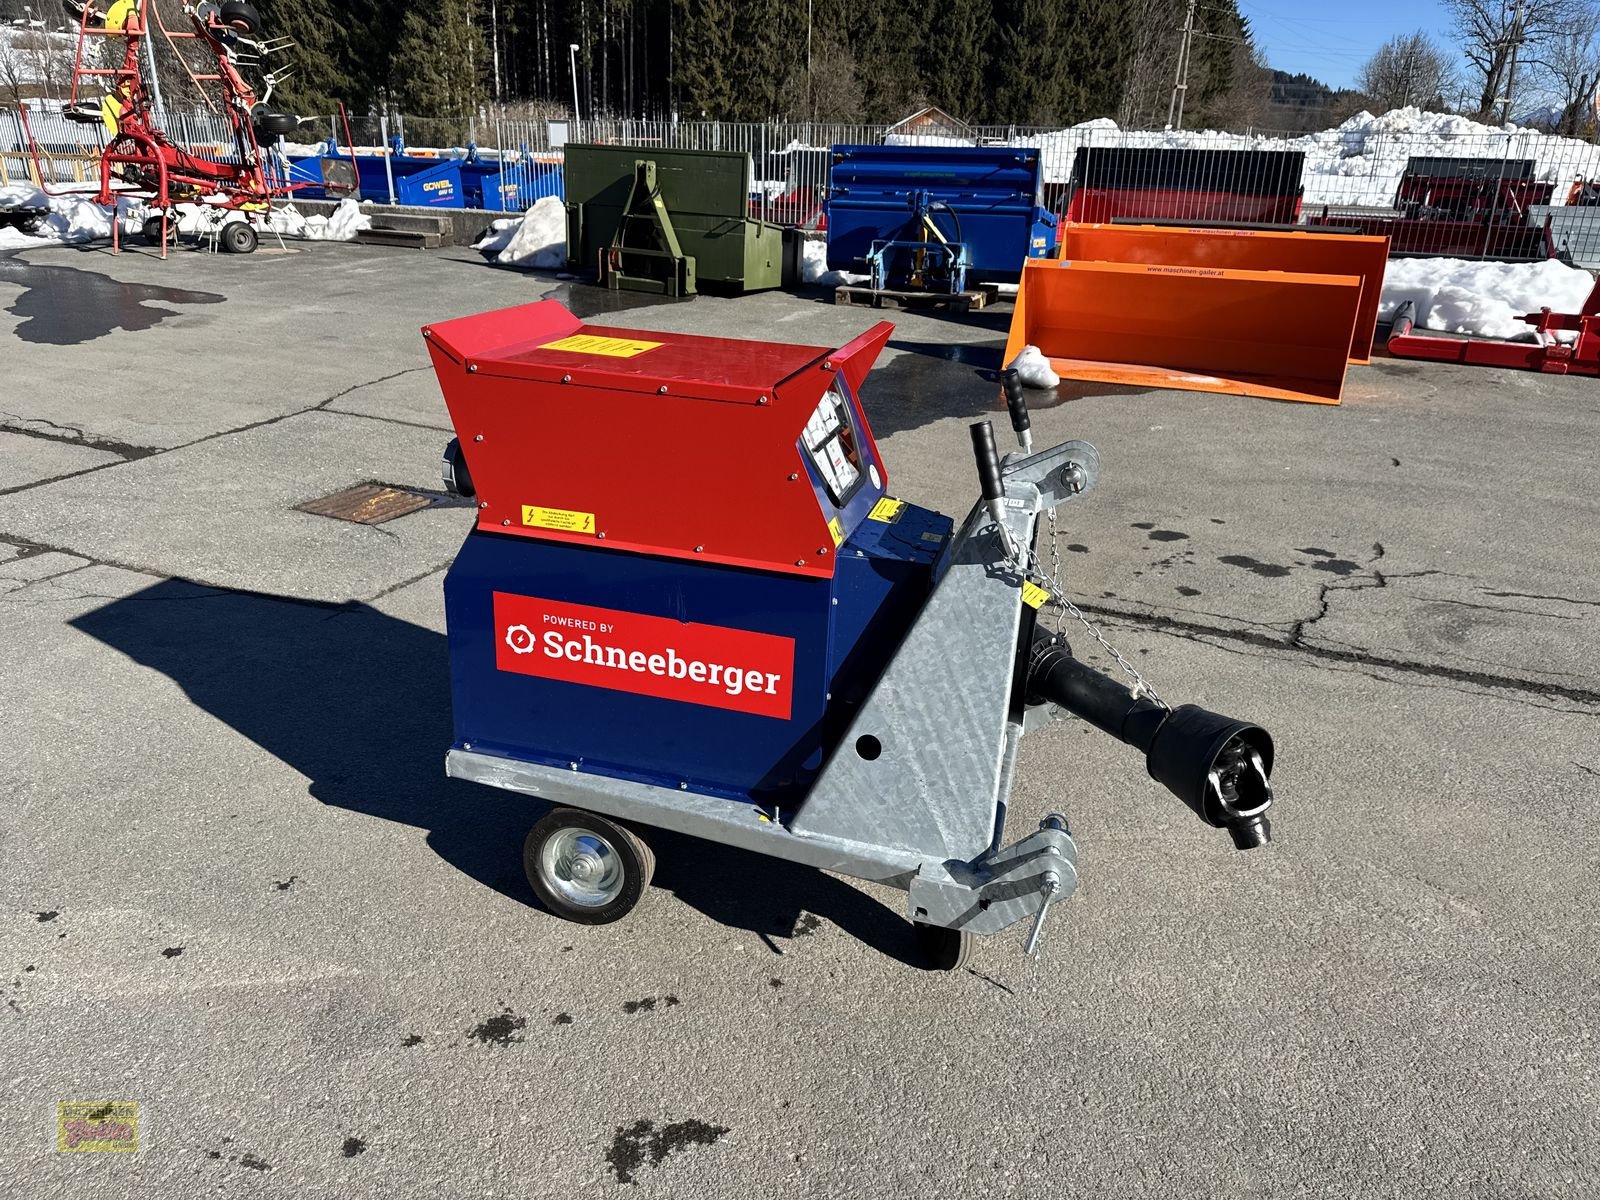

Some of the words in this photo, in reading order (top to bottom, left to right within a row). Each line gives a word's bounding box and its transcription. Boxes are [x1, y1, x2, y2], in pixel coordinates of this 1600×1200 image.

[1147, 266, 1225, 276] www.maschinen-gailer.at
[543, 614, 597, 631] POWERED
[600, 624, 614, 634] BY
[543, 631, 781, 696] Schneeberger
